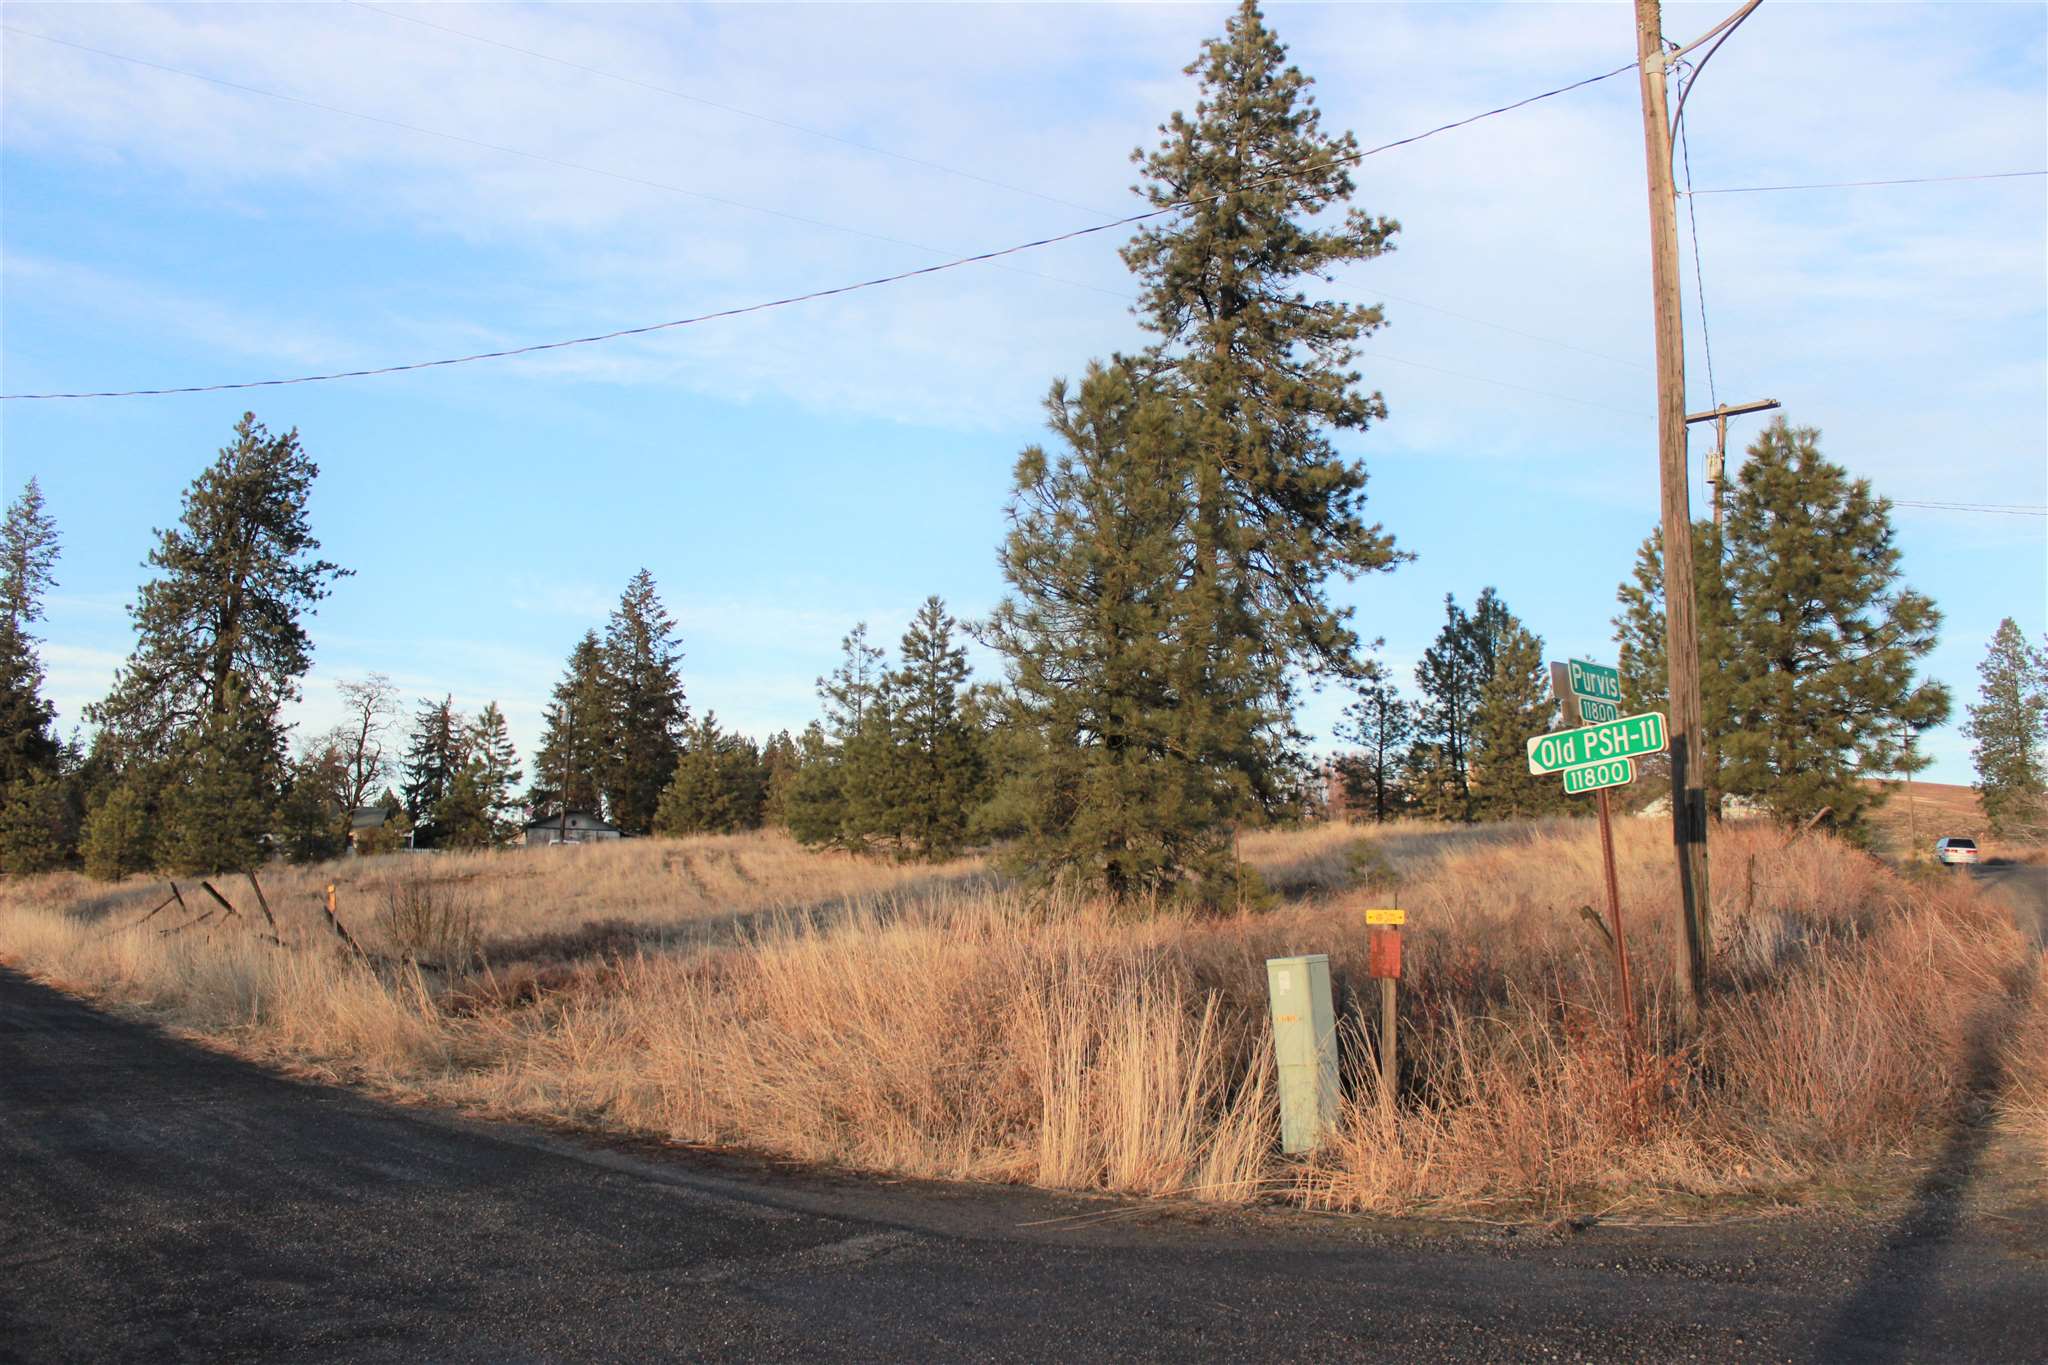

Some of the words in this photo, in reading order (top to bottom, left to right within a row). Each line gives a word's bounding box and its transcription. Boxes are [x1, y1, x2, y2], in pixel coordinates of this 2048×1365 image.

[1571, 663, 1618, 697] Purvis
[1583, 701, 1615, 721] 11800
[1541, 737, 1576, 767] Old
[1583, 719, 1658, 759] PSH-11
[1571, 762, 1624, 790] 11800
